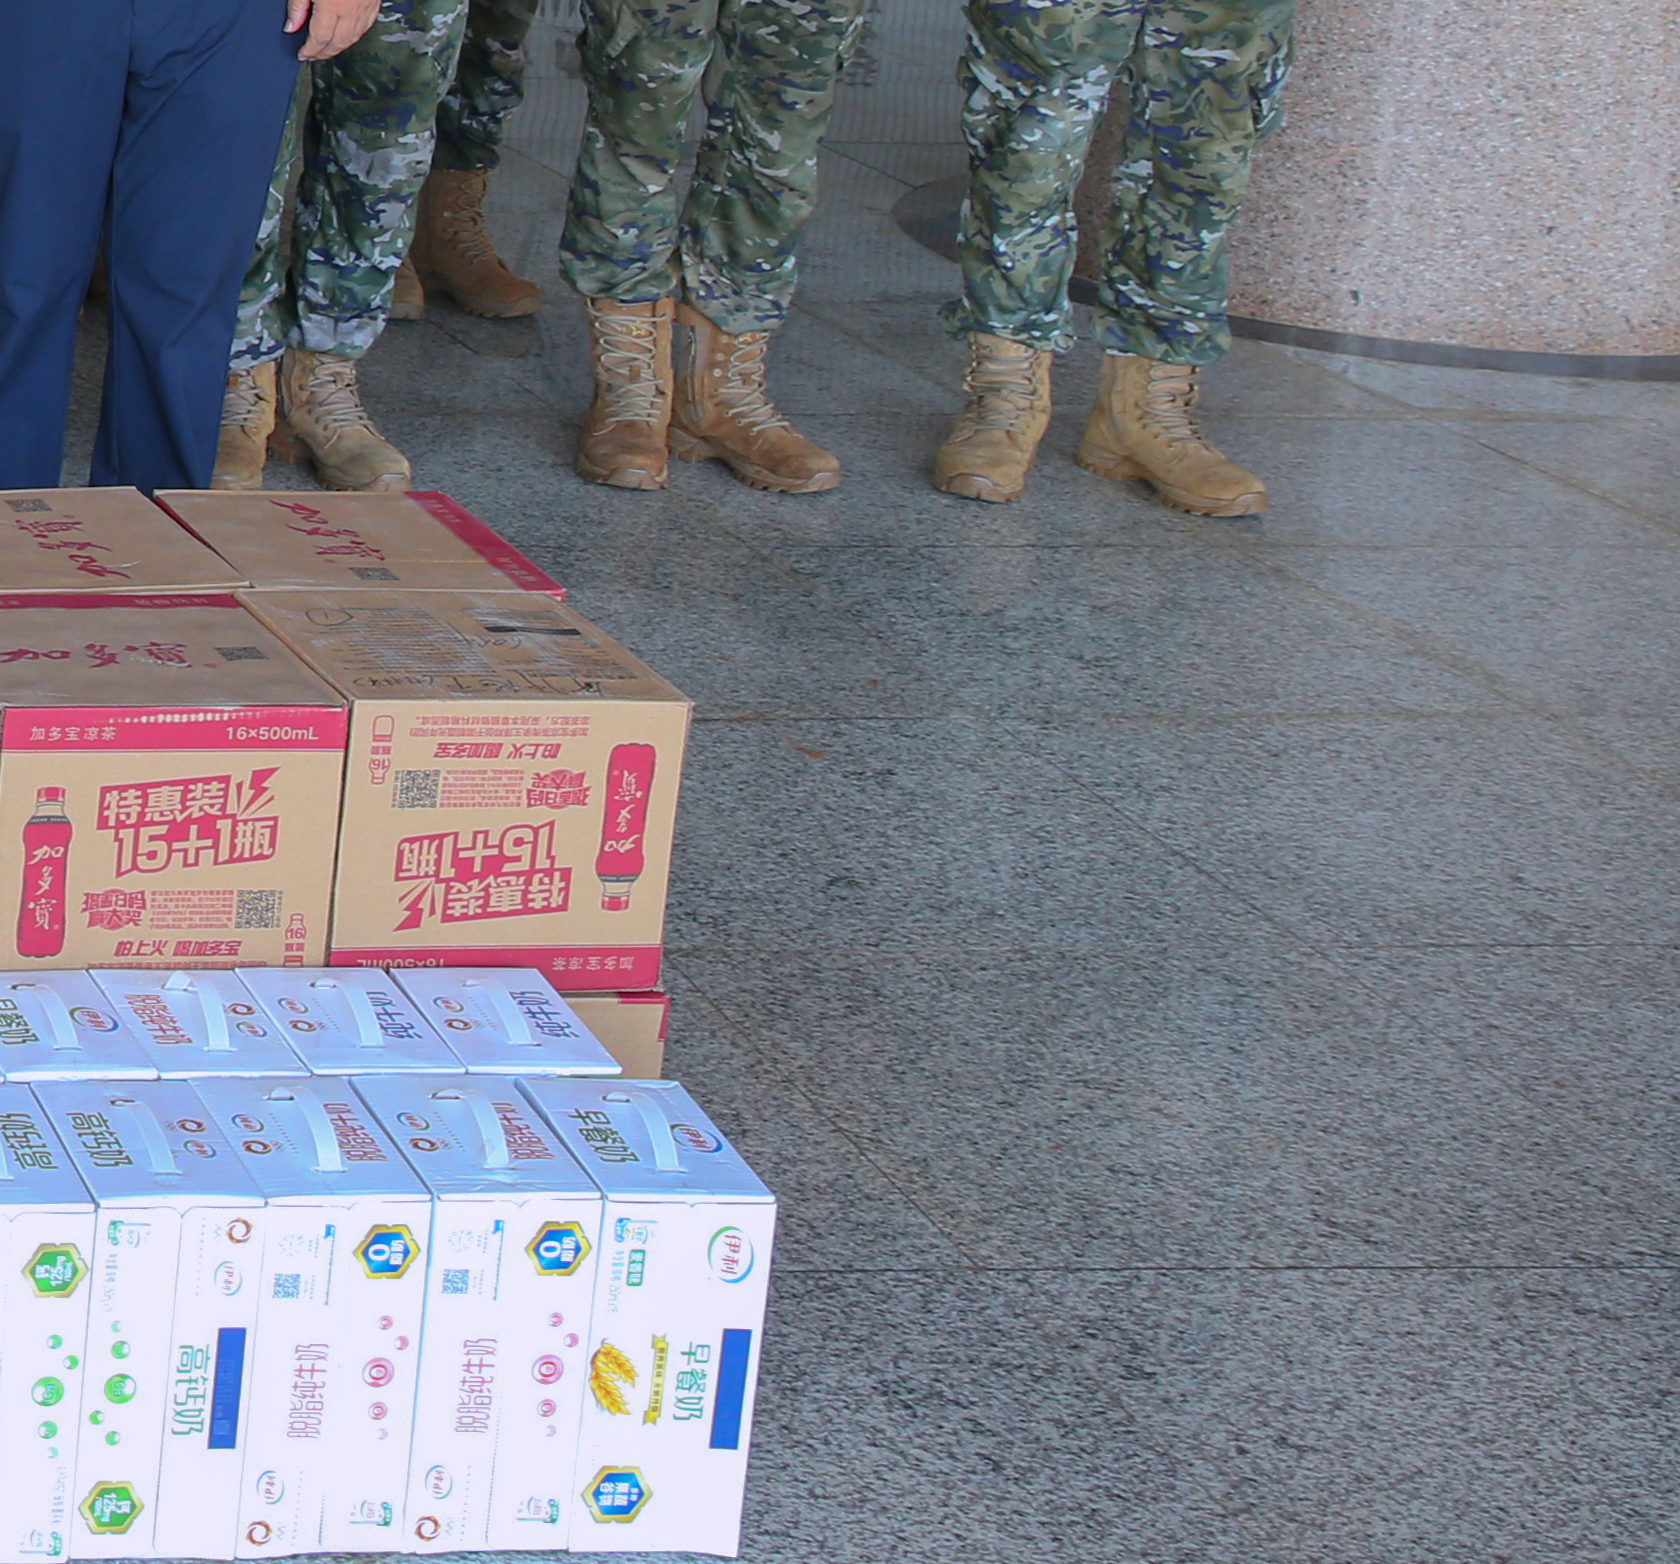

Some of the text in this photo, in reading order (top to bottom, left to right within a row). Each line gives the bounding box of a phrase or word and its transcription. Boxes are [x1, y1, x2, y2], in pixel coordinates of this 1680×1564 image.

[29, 726, 117, 742] 加多宝凉茶
[102, 781, 228, 827] 特惠装
[444, 873, 566, 916] 特惠装
[113, 939, 168, 958] 怕上火
[551, 956, 635, 971] 加多宝凉茶
[171, 1344, 210, 1437] 高钙奶
[287, 1342, 329, 1439] 脱脂纯牛奶
[454, 1337, 498, 1434] 脱脂纯牛奶
[673, 1341, 711, 1422] 早餐奶
